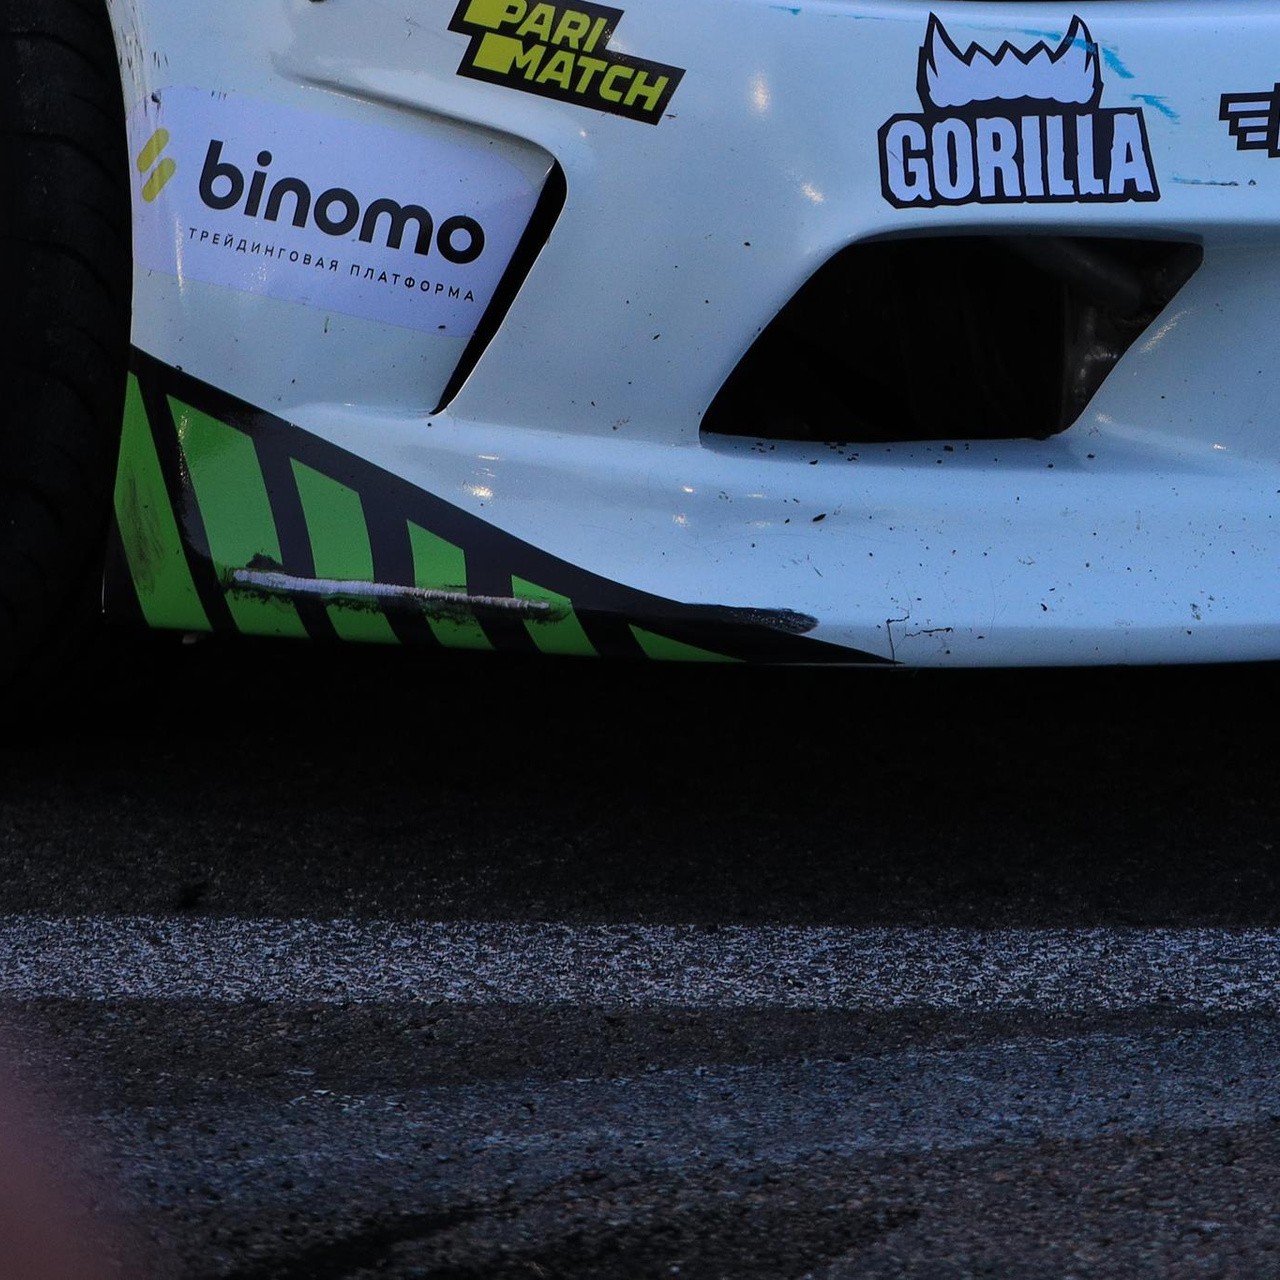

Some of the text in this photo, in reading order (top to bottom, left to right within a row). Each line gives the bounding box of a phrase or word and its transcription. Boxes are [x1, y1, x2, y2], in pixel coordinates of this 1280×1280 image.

[472, 31, 670, 112] MATCH
[884, 114, 1157, 203] GORILLA
[200, 139, 485, 265] binomo
[189, 227, 475, 303] ТРЕЙДИНГОВАЯ ПЛАТФОРМА
